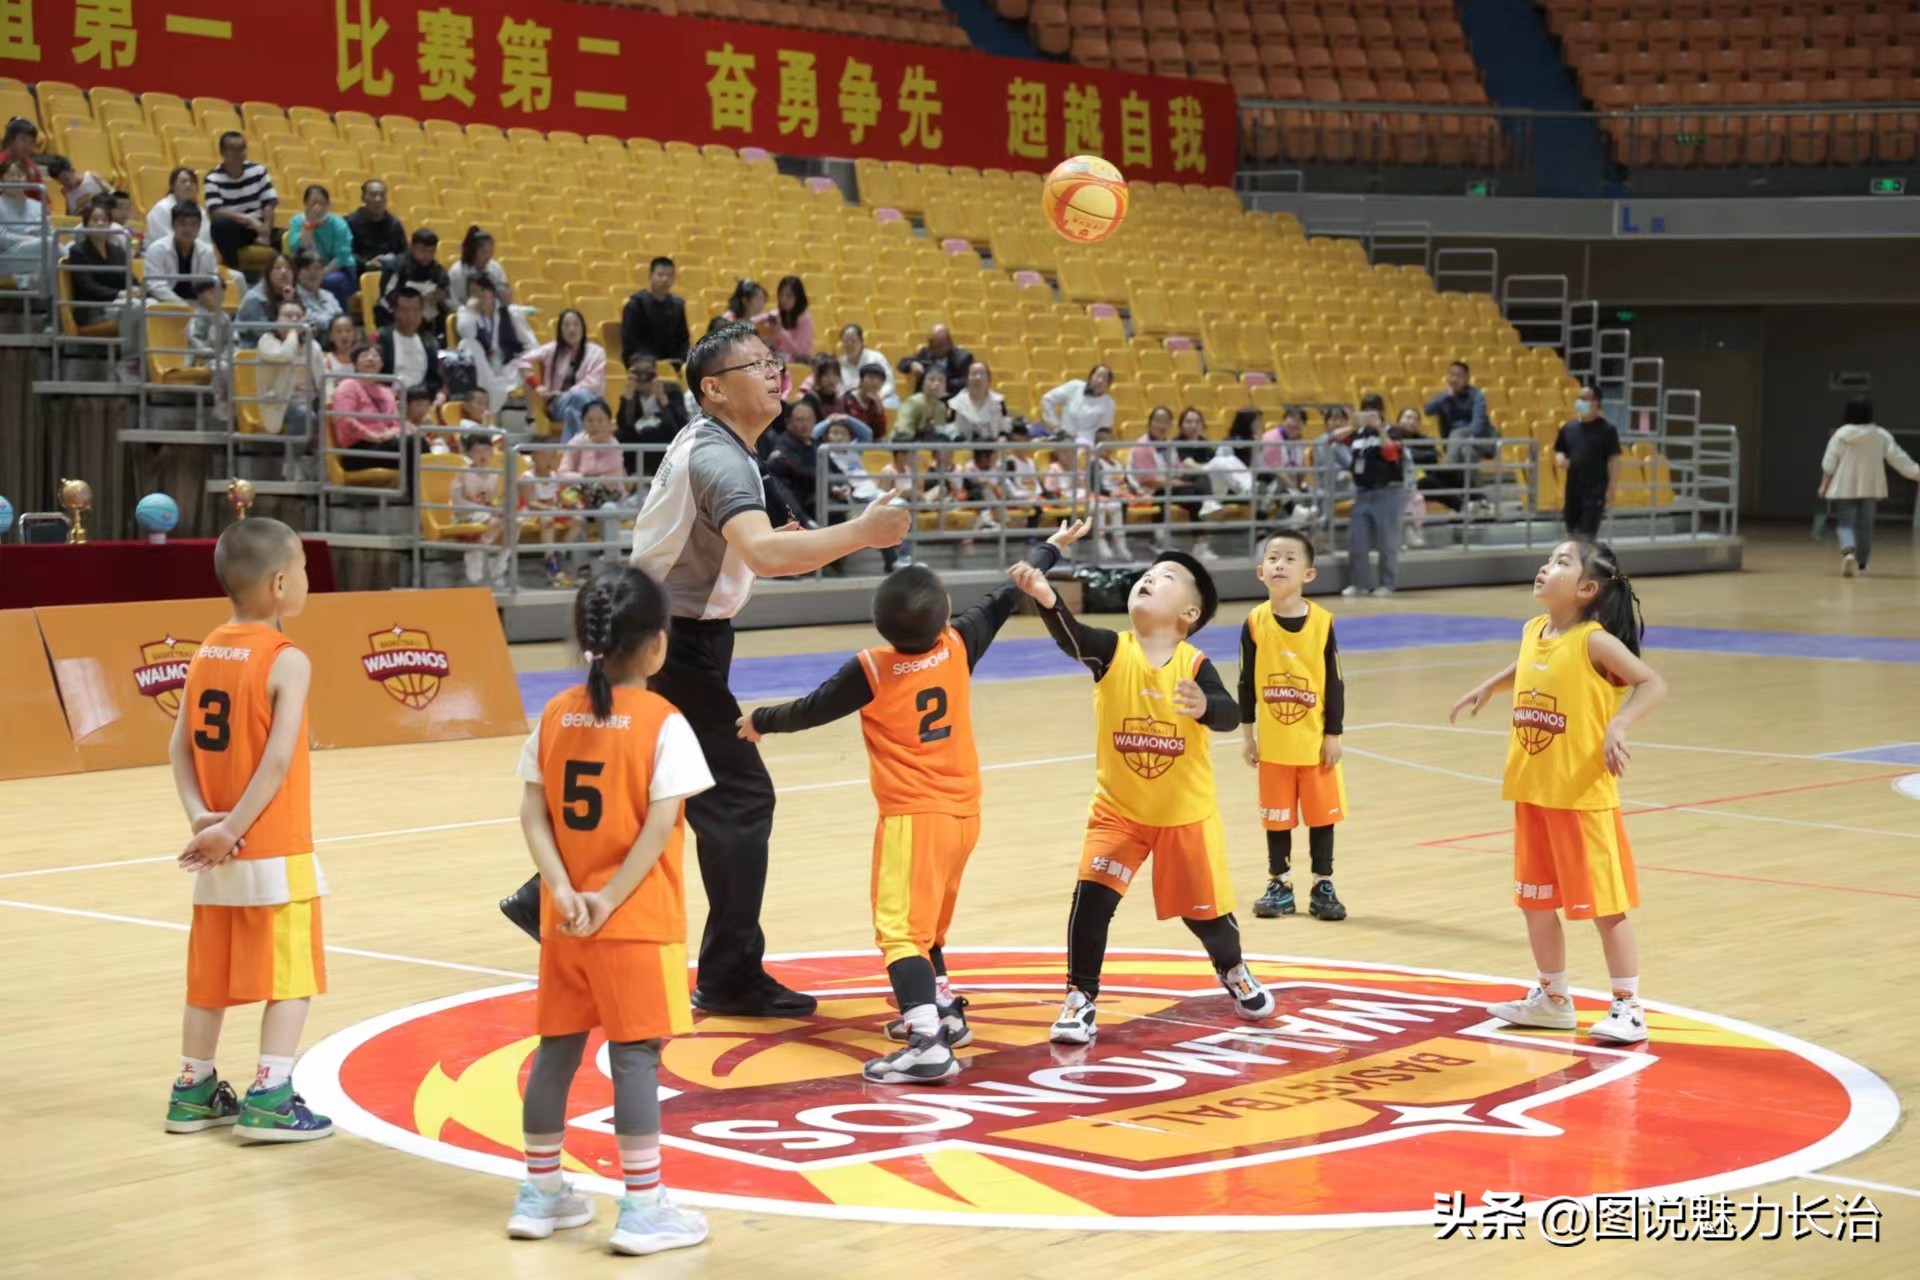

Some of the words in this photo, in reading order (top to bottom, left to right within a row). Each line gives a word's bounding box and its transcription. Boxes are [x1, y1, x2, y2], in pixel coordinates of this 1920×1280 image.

[335, 0, 627, 113] 比赛第二
[705, 42, 943, 149] 奋勇争先
[1007, 77, 1208, 174] 超越自我
[363, 650, 448, 673] WALMONOS
[194, 688, 231, 752] 3
[915, 686, 952, 744] 2
[1114, 734, 1185, 751] WALMONOS
[562, 760, 605, 831] 5
[690, 997, 1463, 1150] WALMONOS
